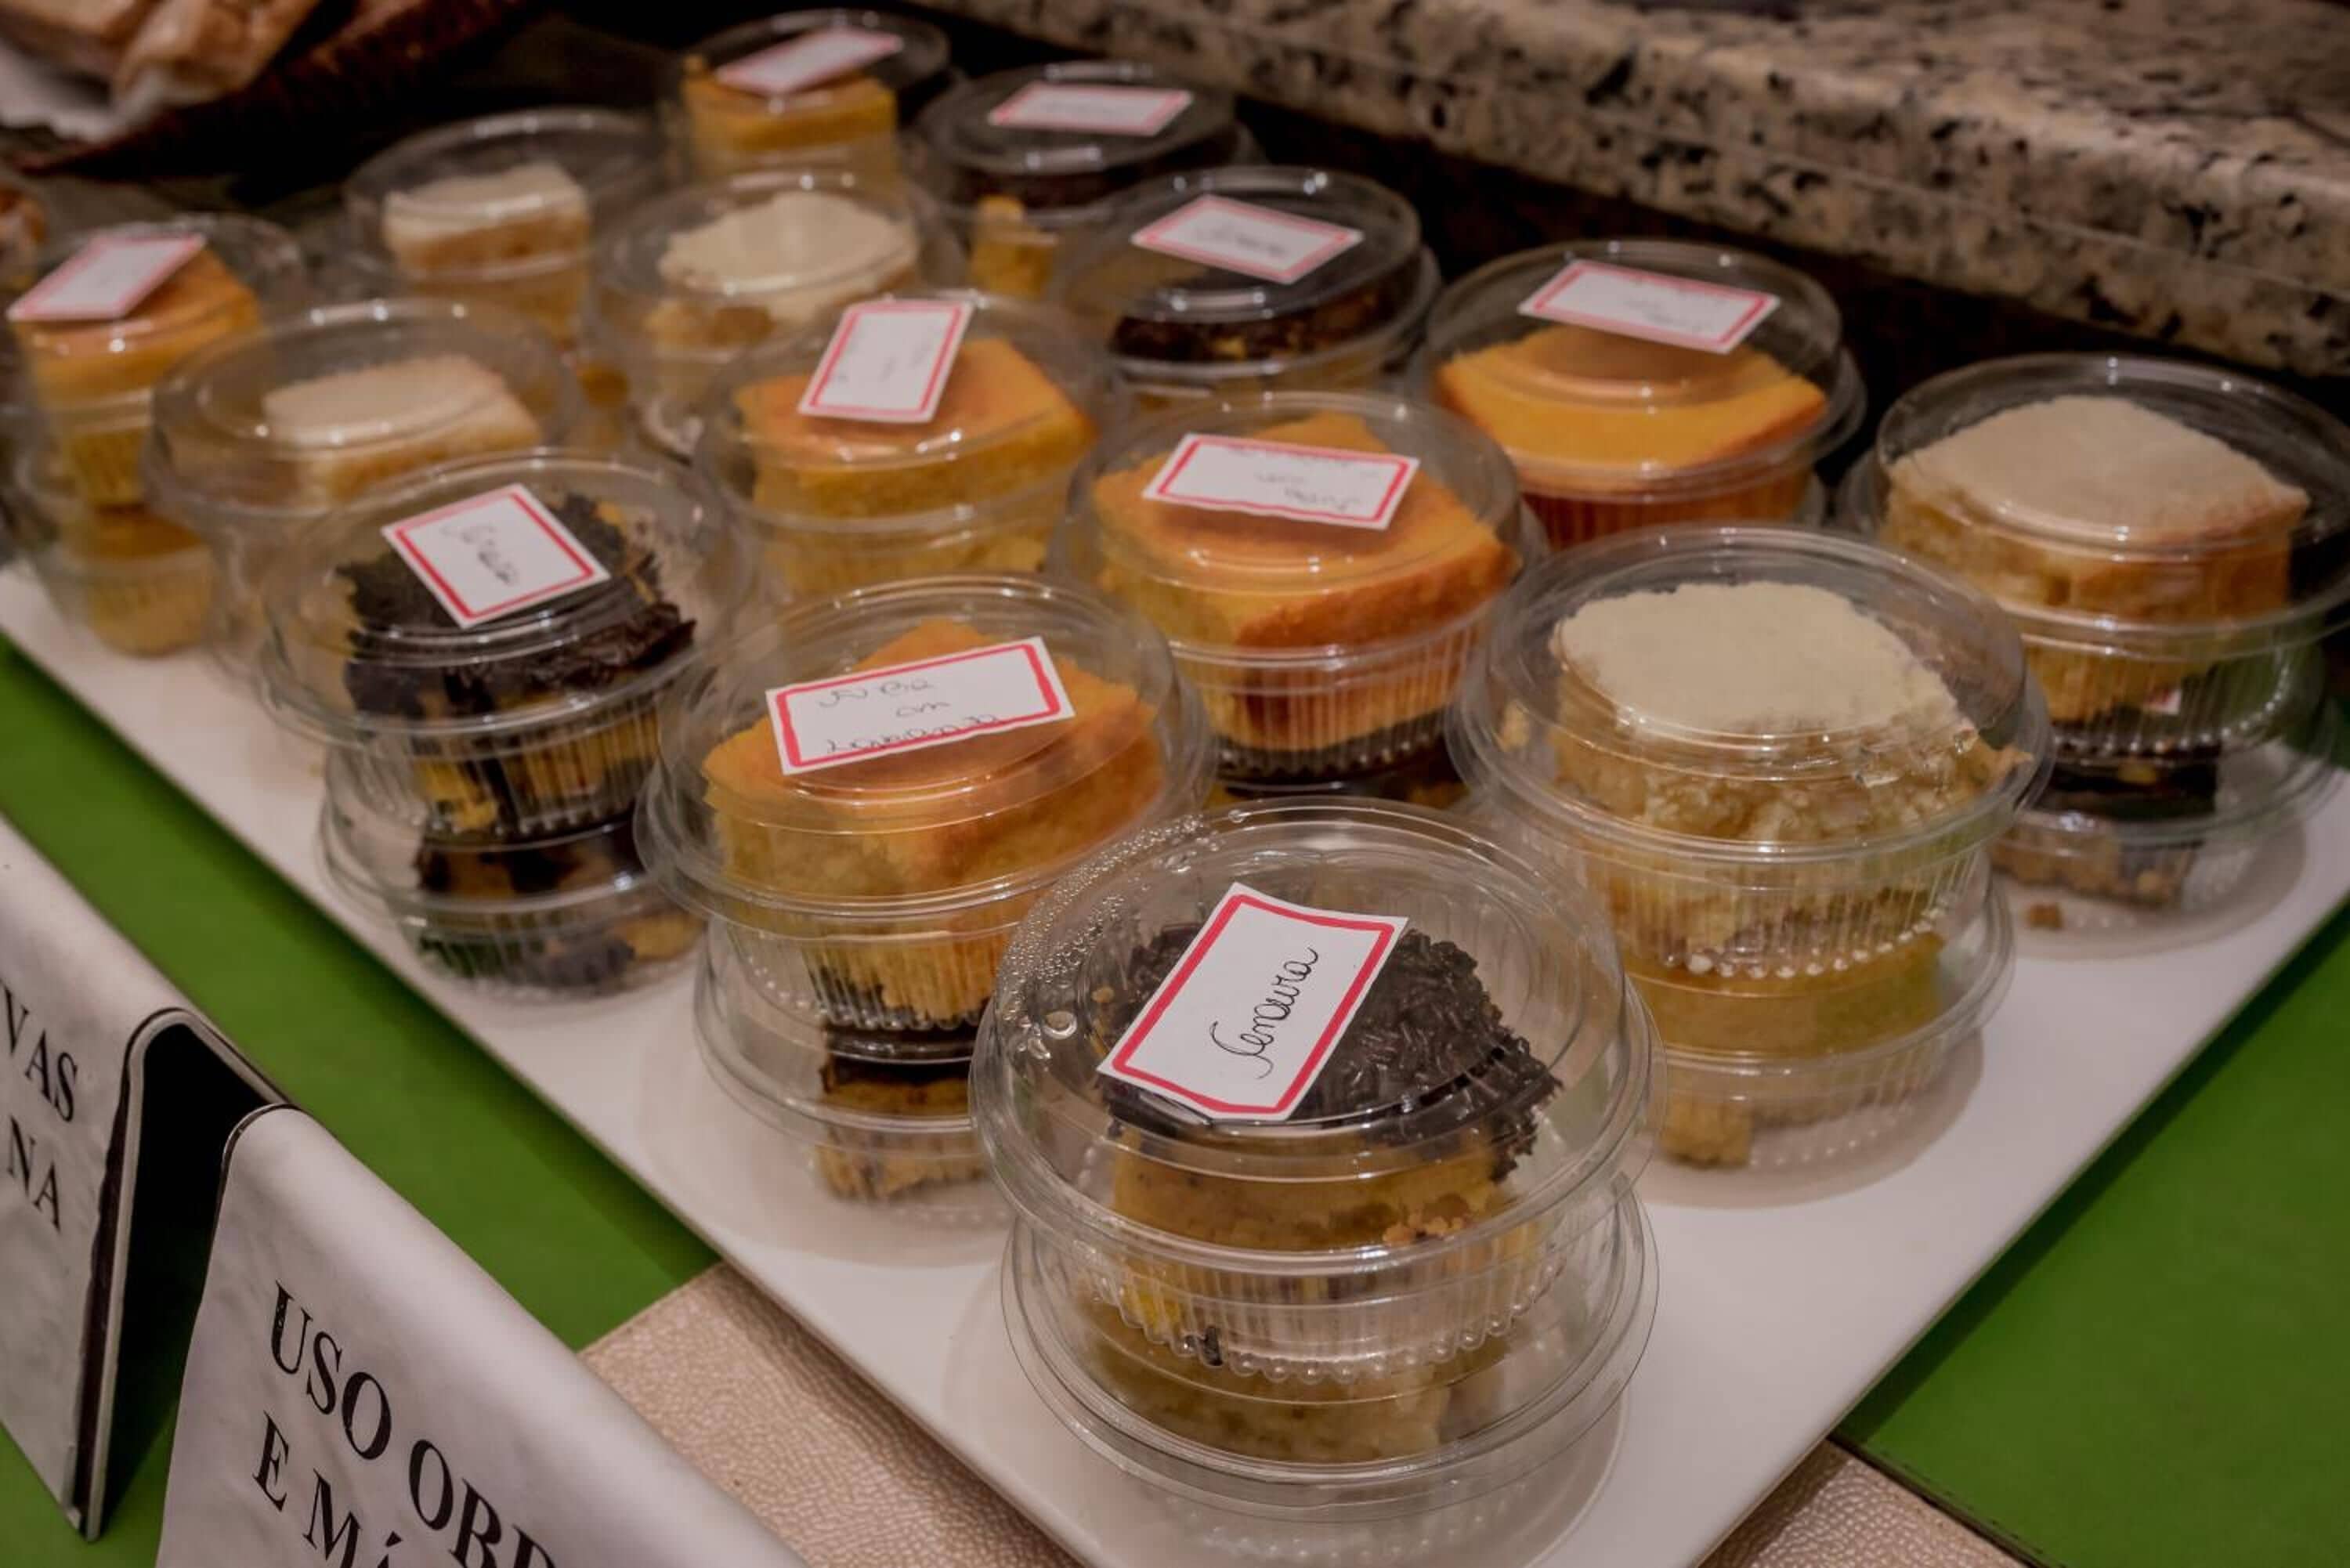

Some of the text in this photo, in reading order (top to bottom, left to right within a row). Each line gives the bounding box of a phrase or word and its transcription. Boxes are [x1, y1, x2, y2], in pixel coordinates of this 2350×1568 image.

[0, 978, 78, 1122] VAS
[7, 1113, 61, 1234] NA
[270, 1279, 392, 1461] USO
[252, 1409, 290, 1512] E
